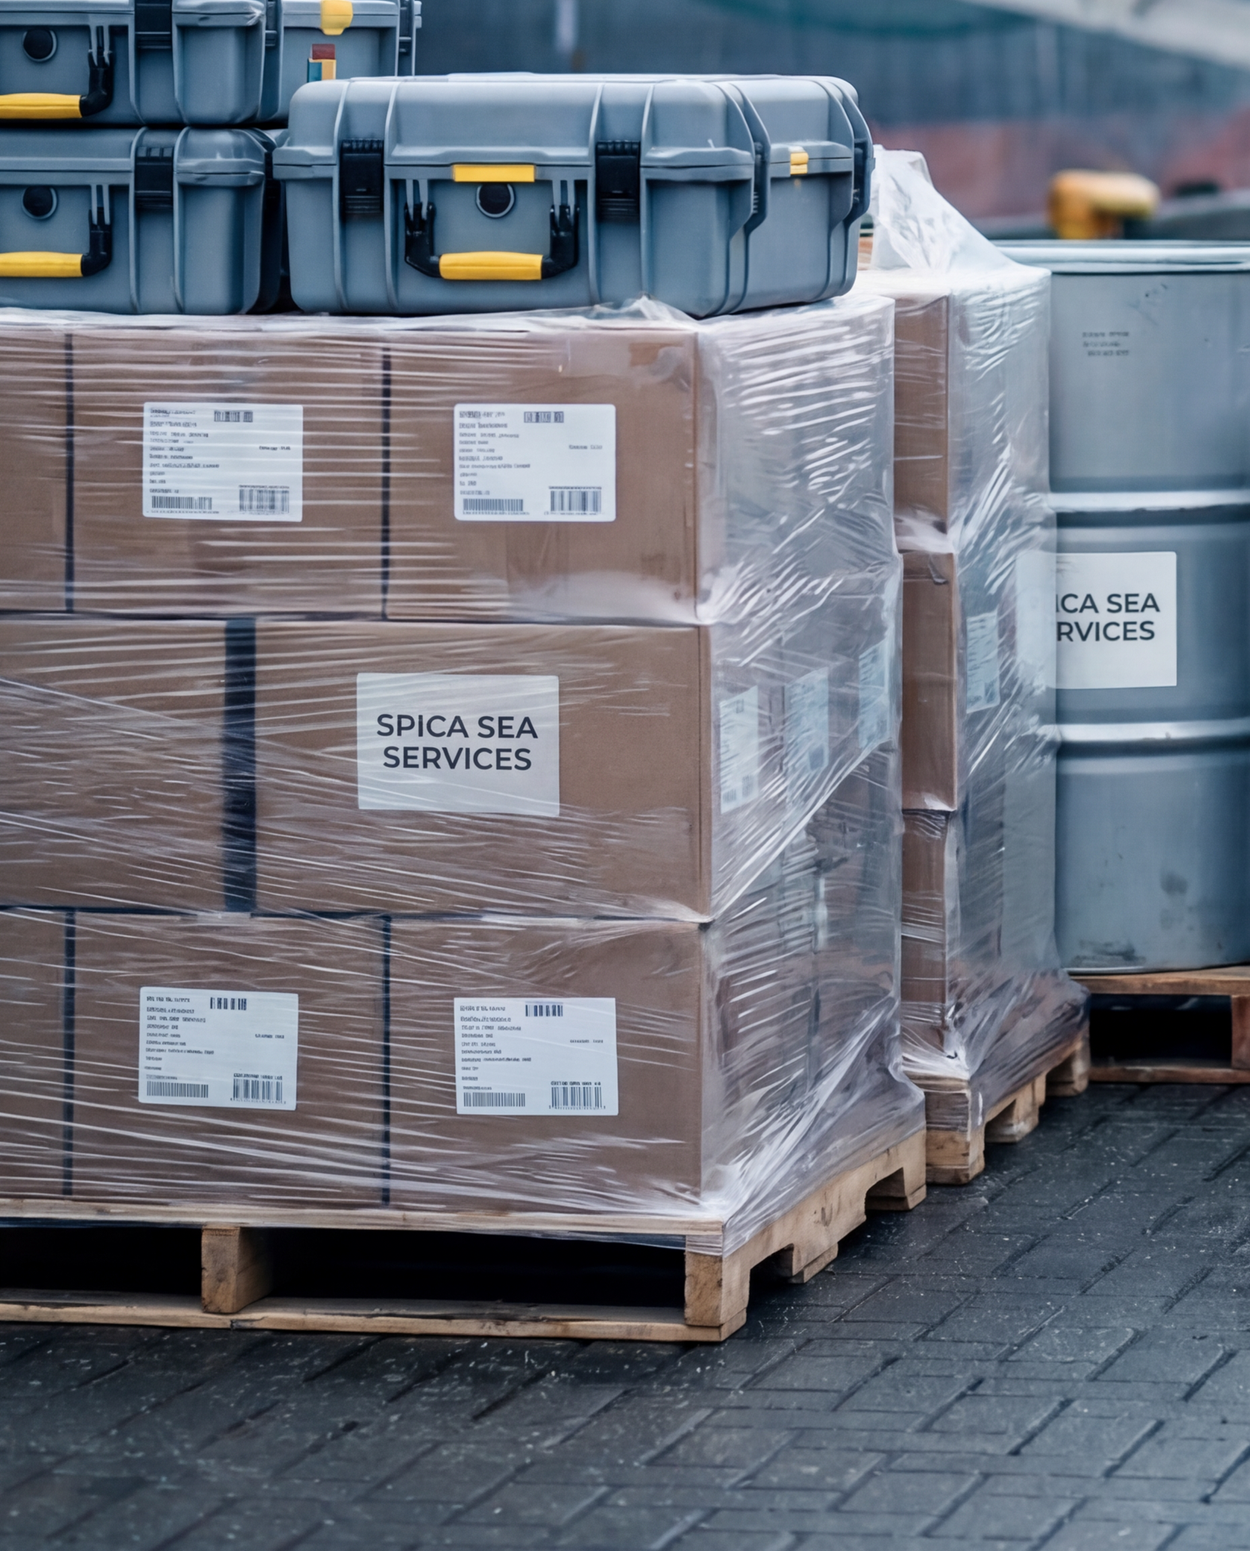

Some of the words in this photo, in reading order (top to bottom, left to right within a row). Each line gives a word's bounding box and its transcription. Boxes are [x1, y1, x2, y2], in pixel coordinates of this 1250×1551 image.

[1056, 593, 1099, 614] ICA
[1106, 592, 1161, 614] SEA
[1056, 620, 1155, 642] RVICES
[376, 713, 470, 739] SPICA
[477, 715, 539, 739] SEA
[383, 746, 532, 771] SERVICES
